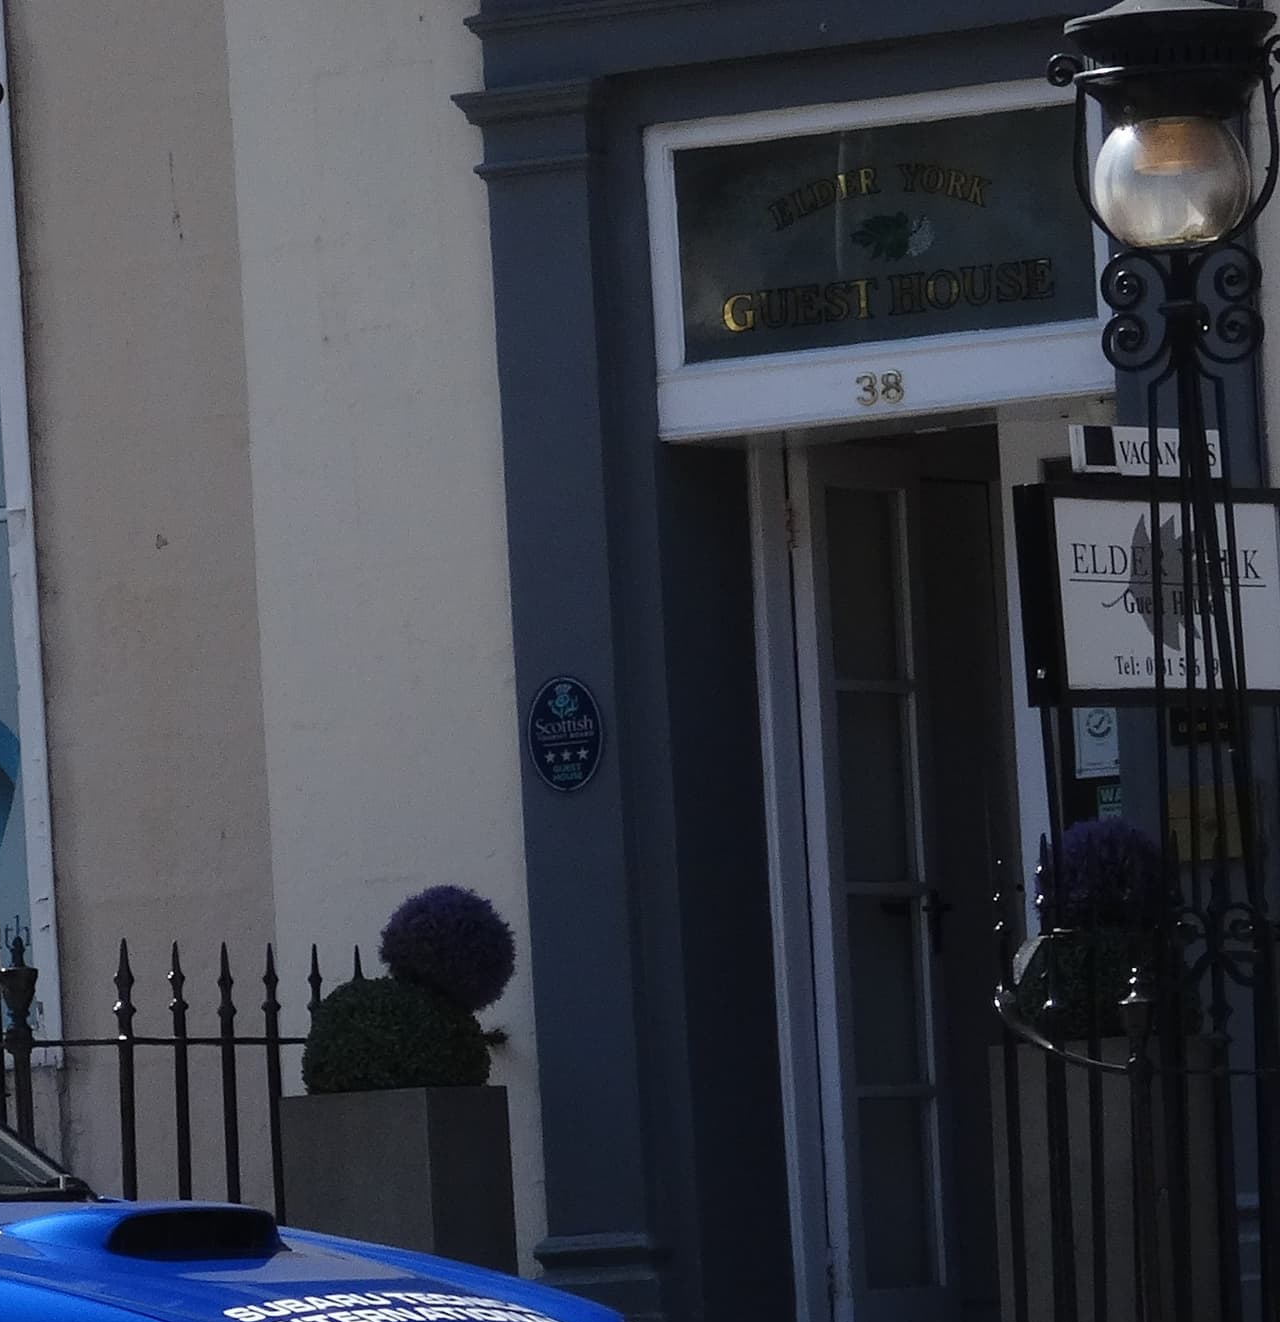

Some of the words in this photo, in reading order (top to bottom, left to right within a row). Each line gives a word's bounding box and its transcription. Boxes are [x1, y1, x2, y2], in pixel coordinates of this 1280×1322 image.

[768, 168, 881, 231] ELDER
[897, 163, 991, 208] YORK
[721, 278, 877, 333] GUEST
[887, 256, 1055, 316] HOUSE
[855, 368, 905, 406] 38
[1114, 655, 1140, 676] Tel:
[536, 715, 593, 734] Scottish
[224, 1292, 391, 1322] SUBARU
